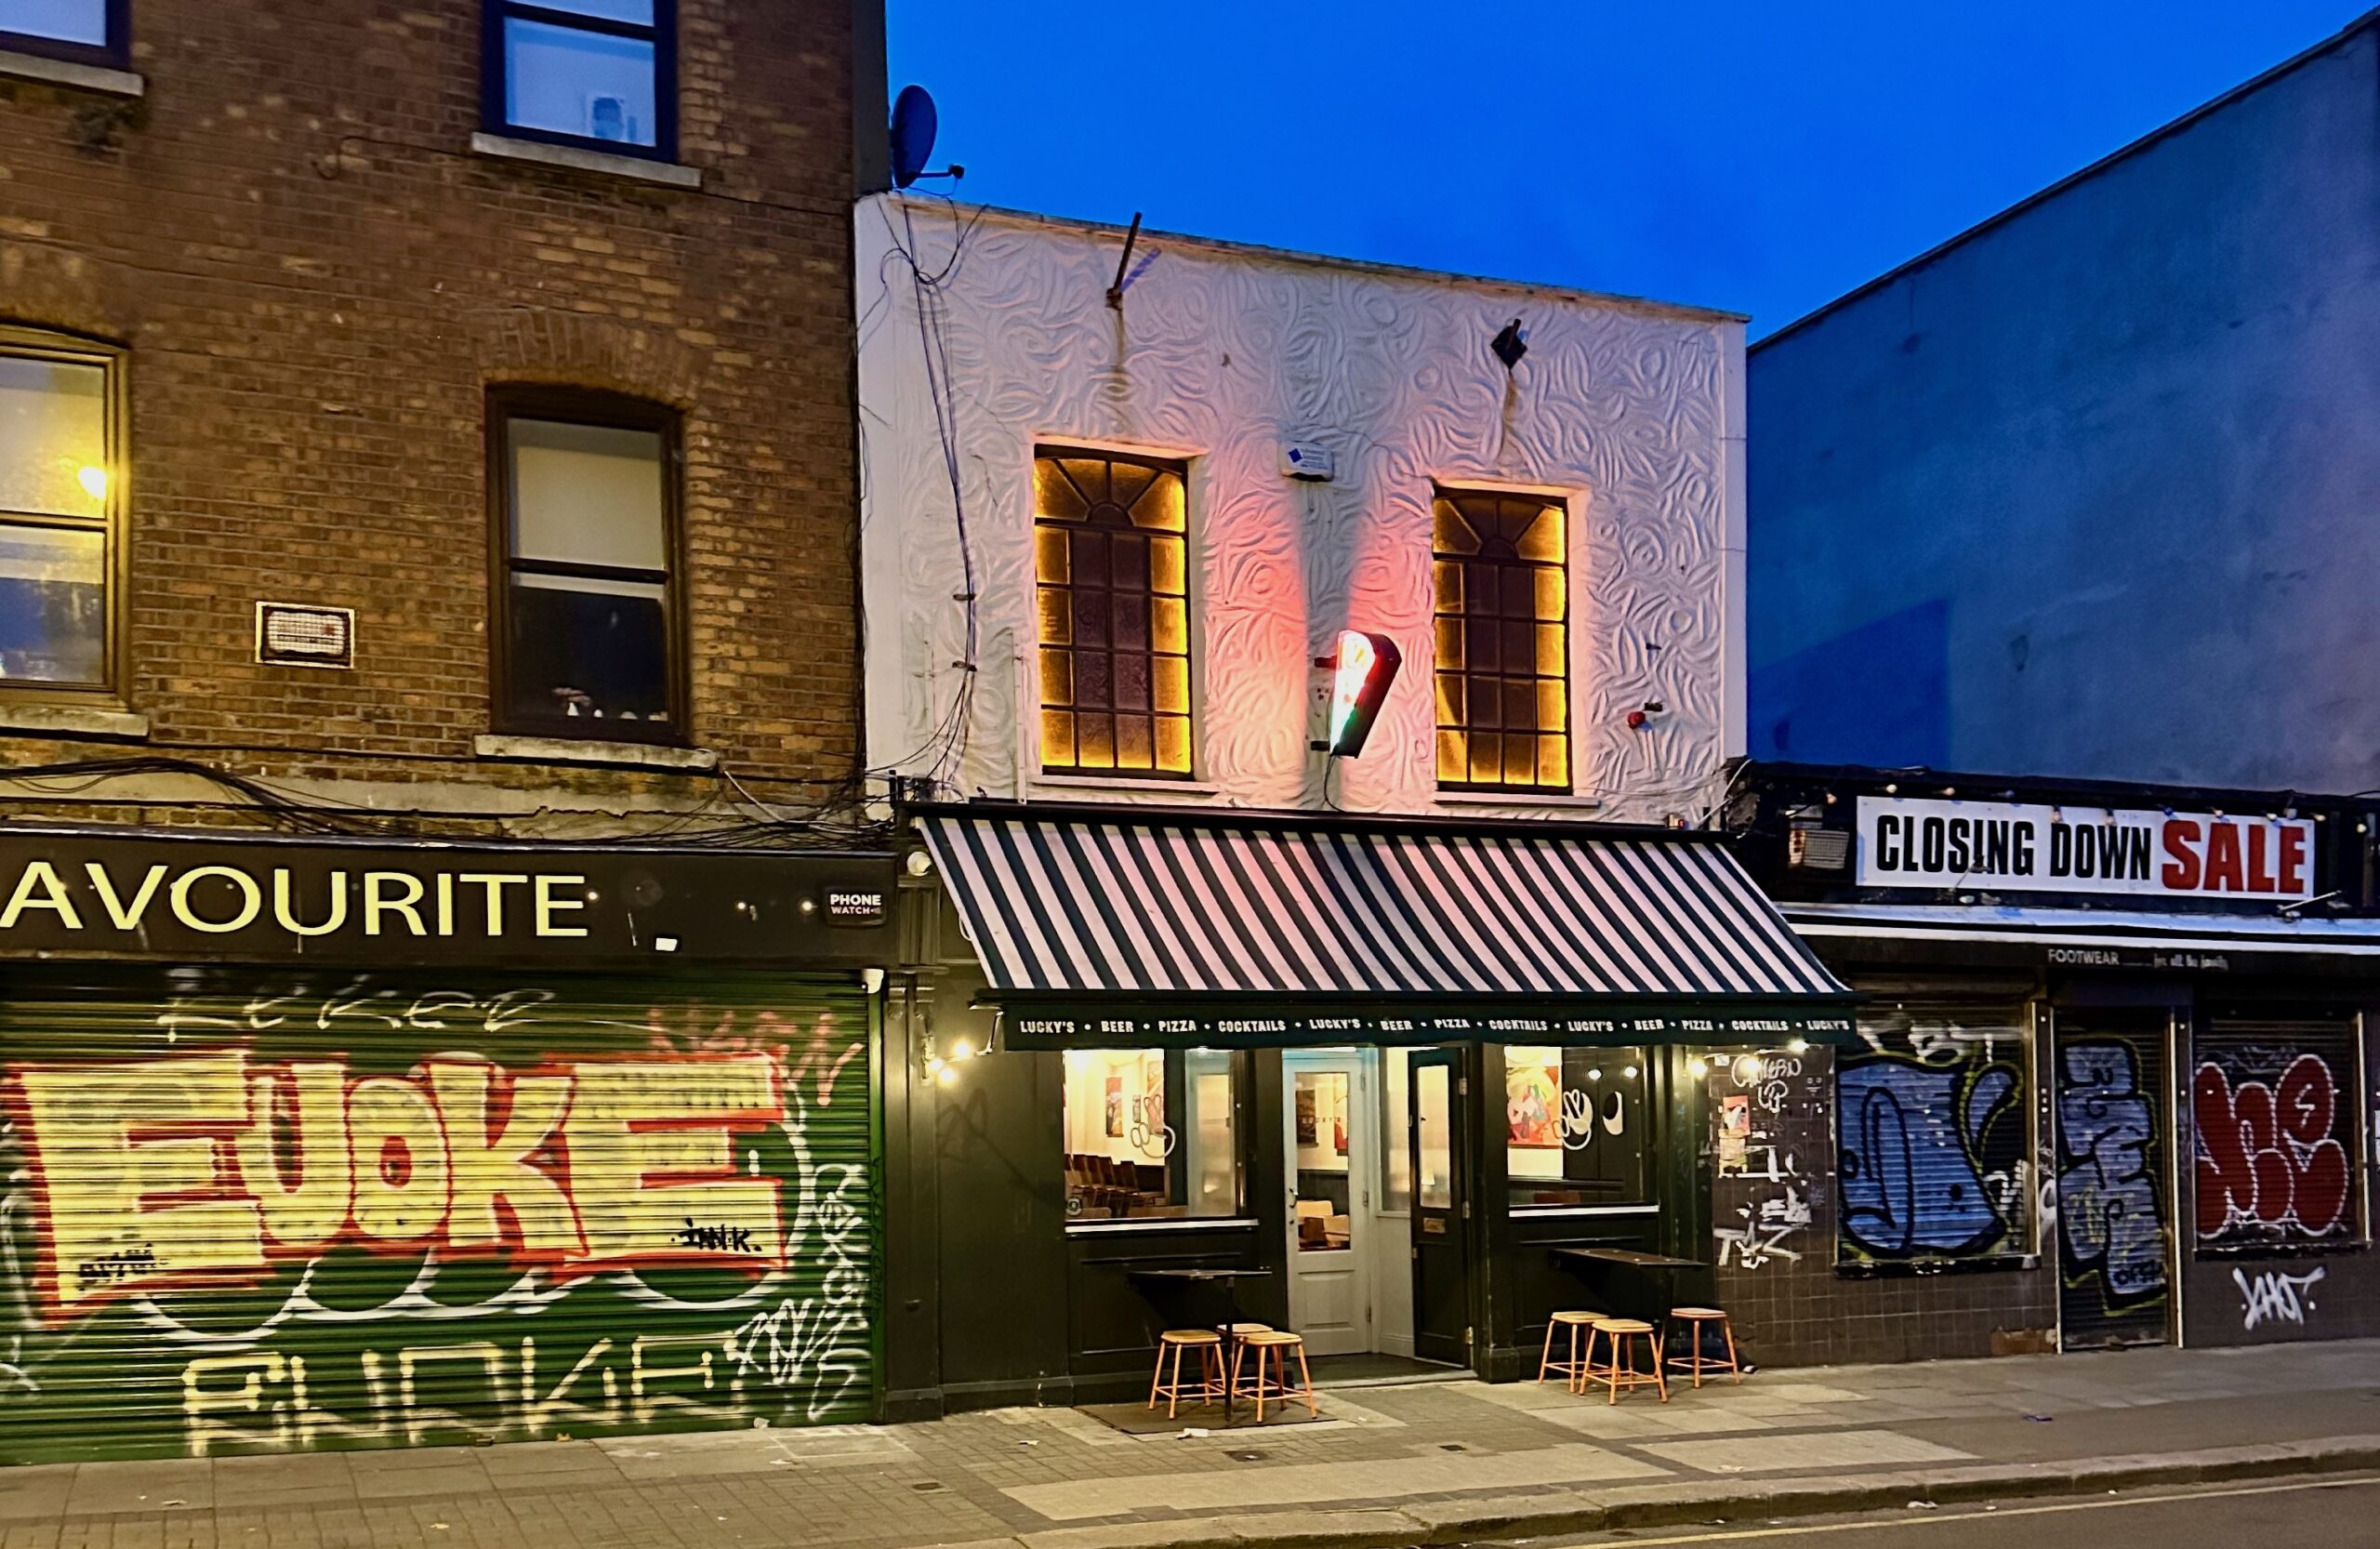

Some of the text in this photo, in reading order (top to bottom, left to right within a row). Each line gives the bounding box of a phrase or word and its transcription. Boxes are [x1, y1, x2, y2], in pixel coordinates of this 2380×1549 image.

[1877, 815, 2306, 894] CLOSING DOWN SALE
[0, 862, 588, 937] AVOURITE
[830, 894, 882, 907] PHONE
[831, 906, 870, 915] WATCH
[2047, 948, 2120, 966] FOOTWEAR
[1020, 1019, 1850, 1034] LUCKY'S BEER PIZZA COCKTAILS LUCKY'S BEER PIZZA COCKTAILS LUCKY'S BEER PIZZA COCKTAILS LUCKY'S
